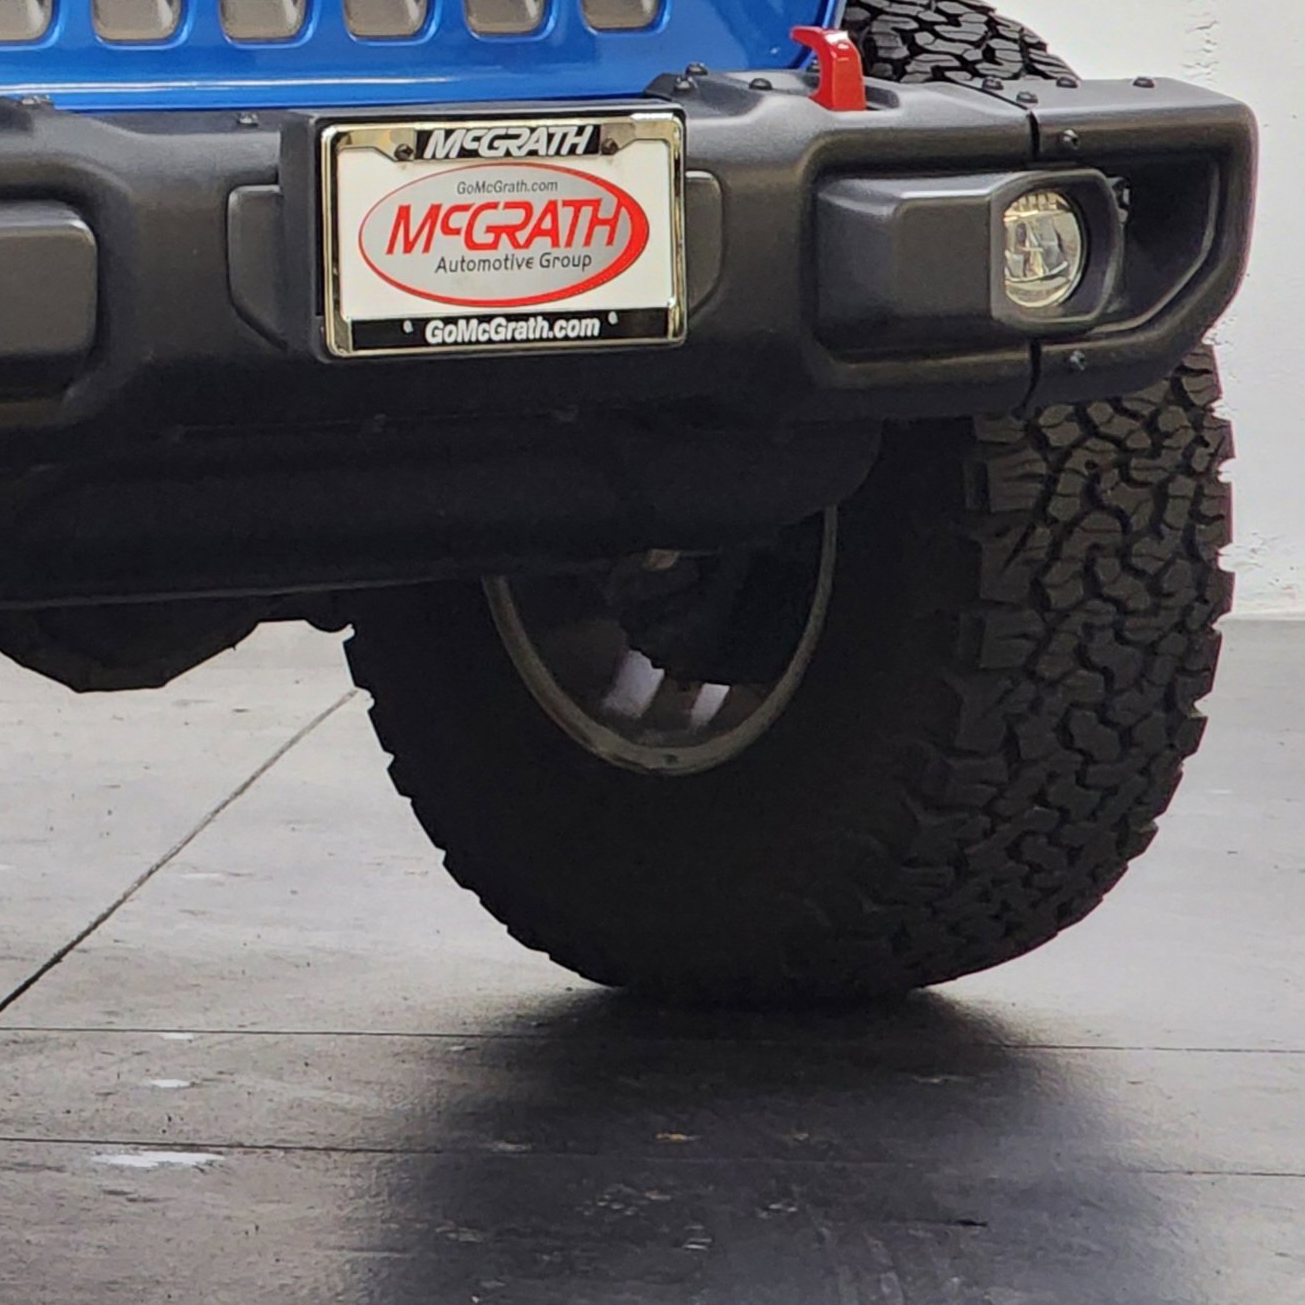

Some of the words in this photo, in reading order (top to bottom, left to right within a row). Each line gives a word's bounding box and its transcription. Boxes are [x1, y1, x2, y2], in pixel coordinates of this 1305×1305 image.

[456, 179, 558, 195] GoMcGrath.com
[434, 254, 535, 274] Automotive
[539, 251, 593, 272] Group
[425, 316, 601, 345] GoMcGrath.com
